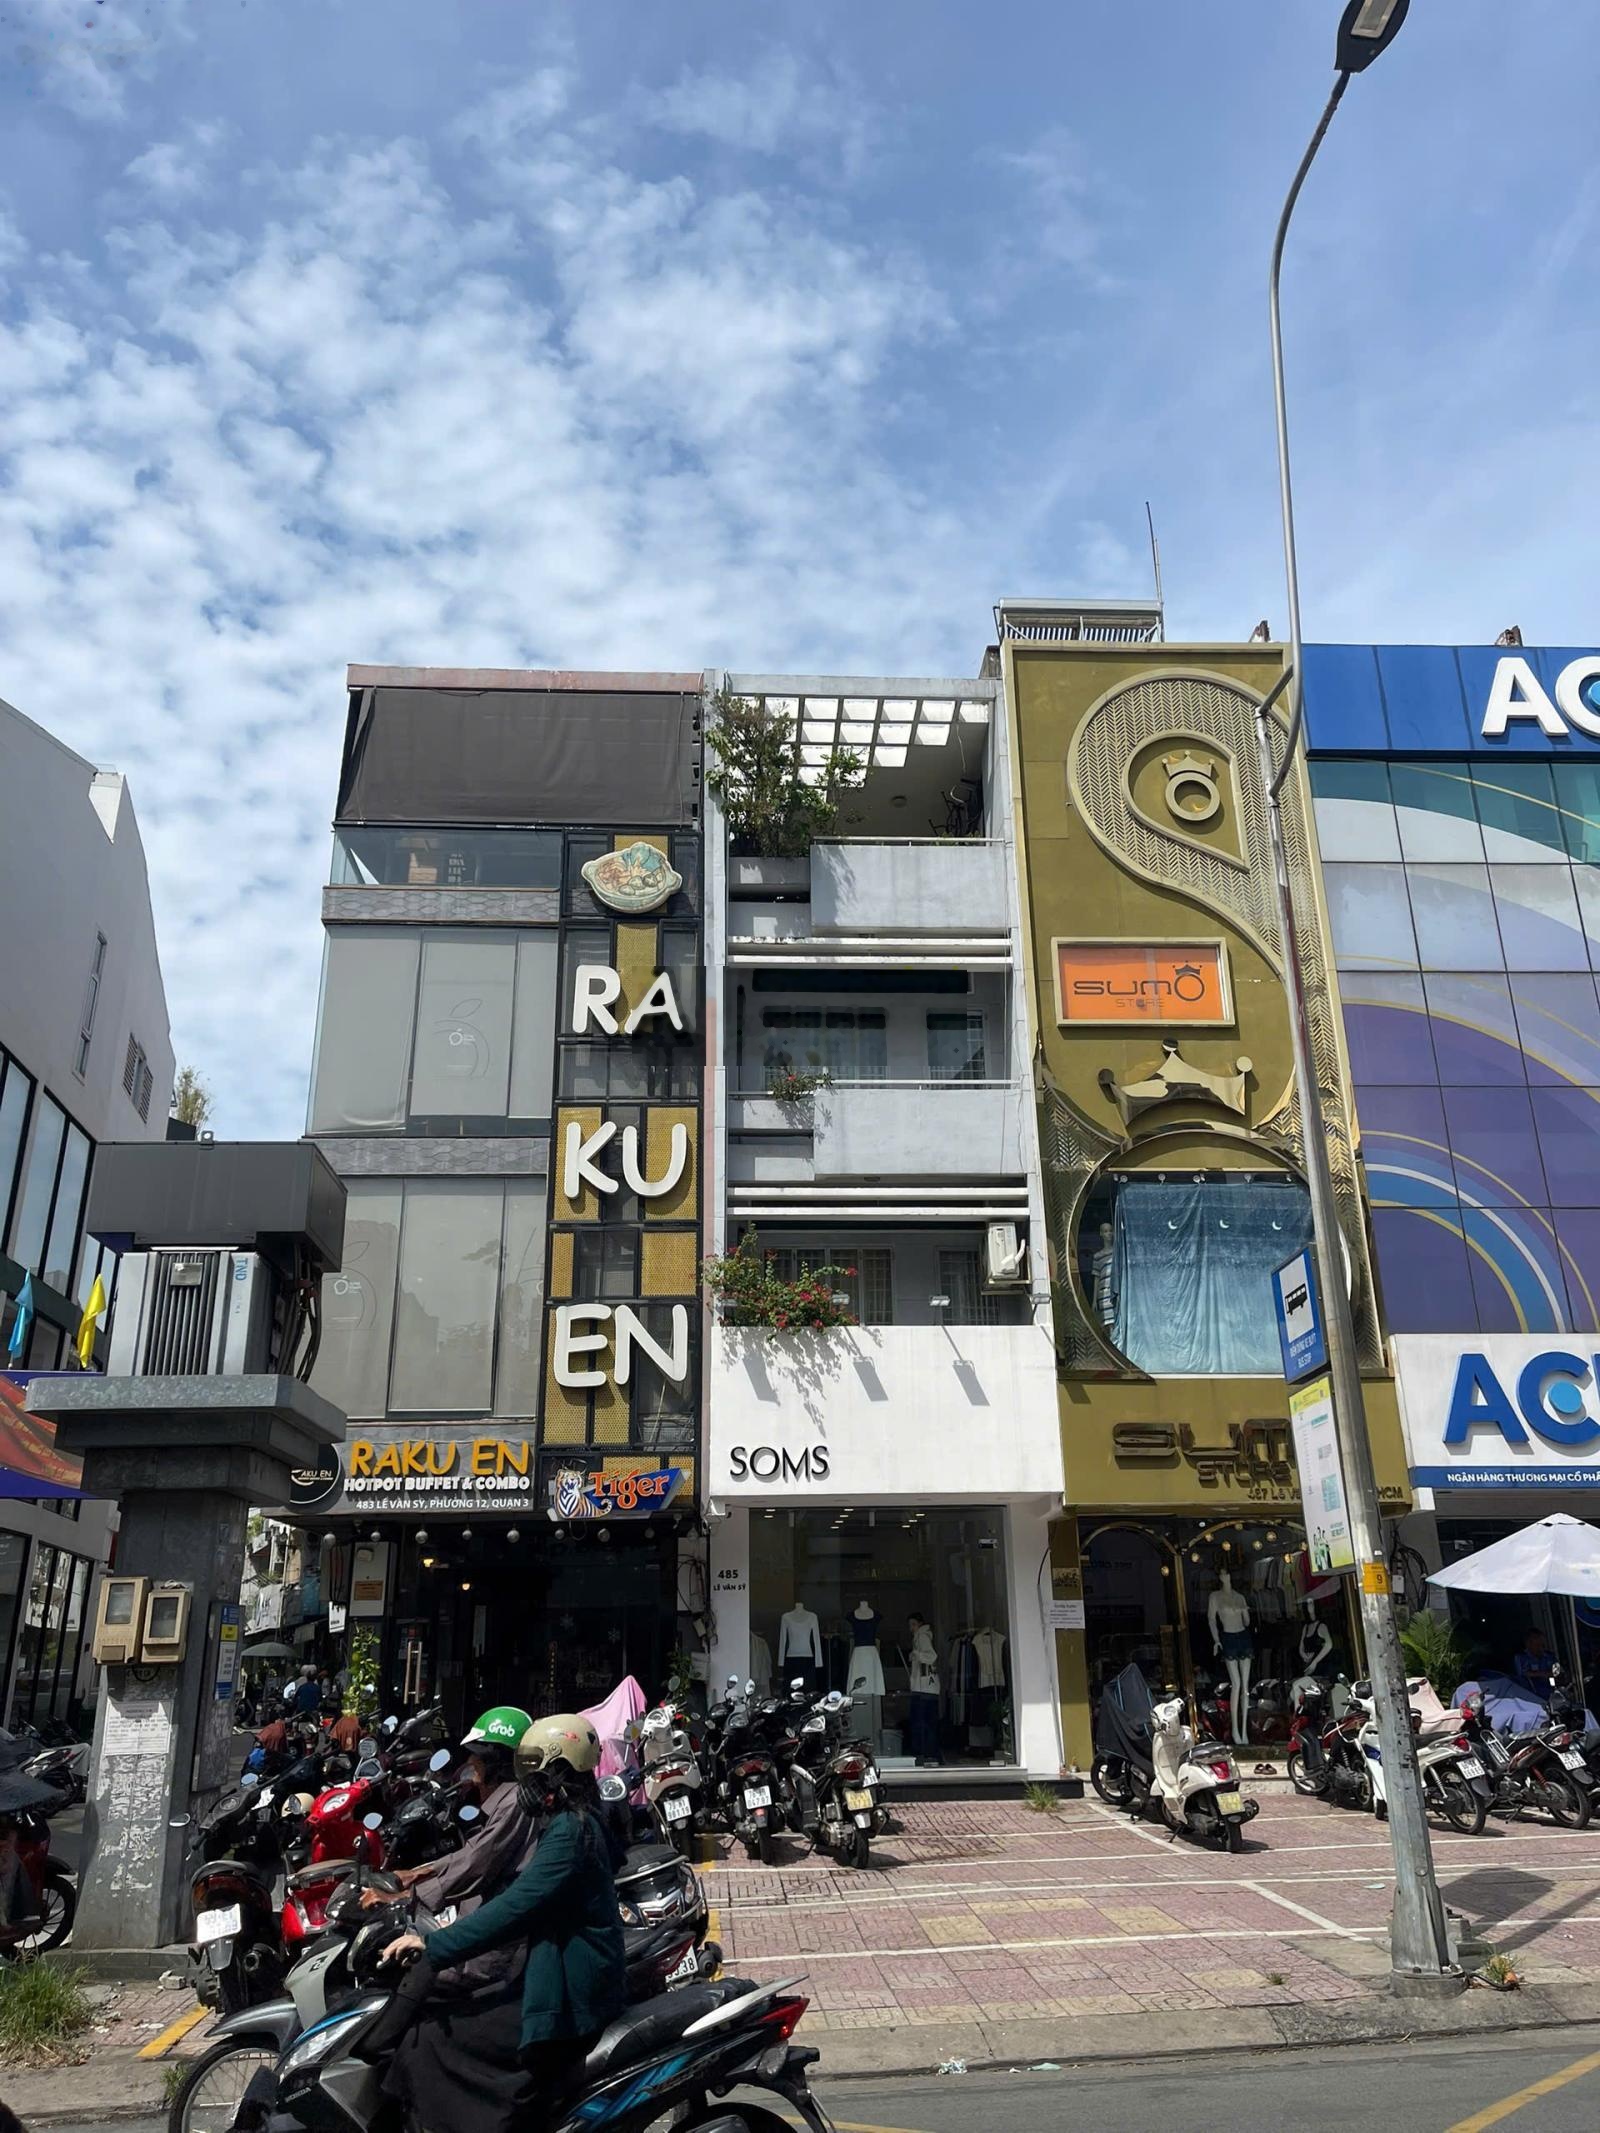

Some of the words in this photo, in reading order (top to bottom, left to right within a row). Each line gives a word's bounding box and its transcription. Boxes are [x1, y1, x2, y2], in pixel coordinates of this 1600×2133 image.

[572, 964, 683, 1035] RA
[564, 1121, 688, 1198] KU
[553, 1303, 689, 1388] EN
[1443, 1351, 1600, 1445] AC
[351, 1440, 456, 1477] RAKU
[471, 1440, 529, 1476] EN
[730, 1446, 829, 1477] SOMS
[344, 1477, 402, 1492] HOTPOT
[405, 1477, 459, 1491] BUFFET
[461, 1477, 473, 1491] &
[477, 1475, 530, 1490] COMBO
[588, 1468, 670, 1510] Tiger
[1447, 1472, 1475, 1482] NGÂN
[1476, 1471, 1505, 1482] HÀNG
[1505, 1472, 1548, 1483] THƯƠNG
[356, 1501, 374, 1510] 483
[475, 1499, 490, 1511] 12,
[522, 1499, 529, 1509] 3
[718, 1569, 739, 1579] 485
[488, 1719, 515, 1737] Grab
